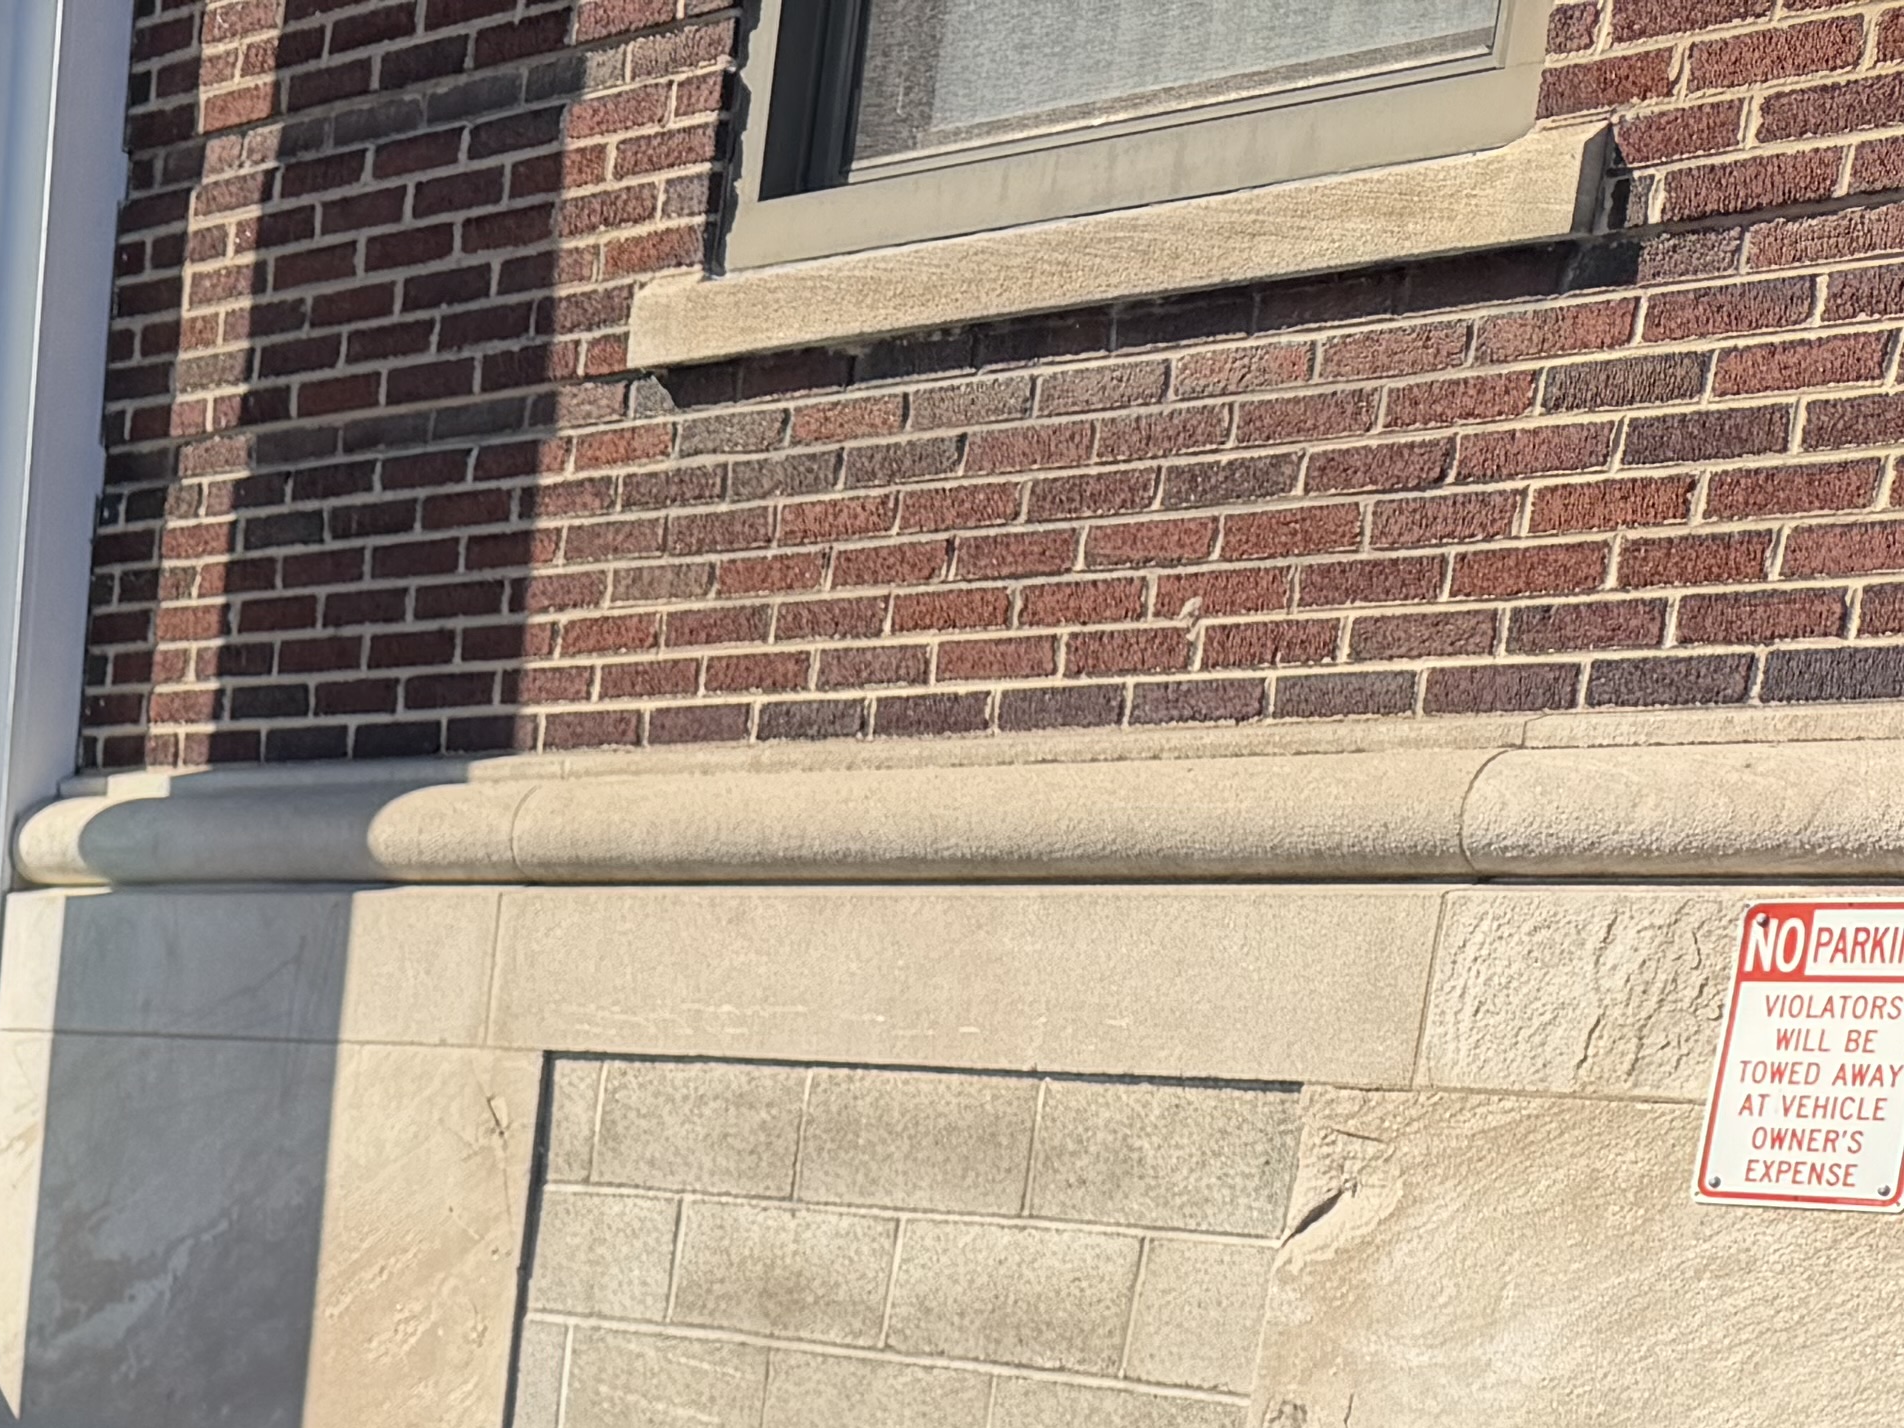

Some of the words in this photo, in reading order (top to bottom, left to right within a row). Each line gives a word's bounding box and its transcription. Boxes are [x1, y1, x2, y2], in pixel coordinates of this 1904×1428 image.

[1744, 916, 1805, 973] NO
[1765, 994, 1904, 1020] VIOLATORS
[1776, 1028, 1831, 1052] WILL
[1844, 1029, 1879, 1053] BE
[1740, 1060, 1821, 1085] TOWED
[1831, 1063, 1904, 1088] AWAY
[1738, 1093, 1771, 1117] AT
[1782, 1095, 1888, 1121] VEHICLE
[1752, 1126, 1865, 1154] OWNER'S
[1744, 1159, 1859, 1187] EXPENSE
